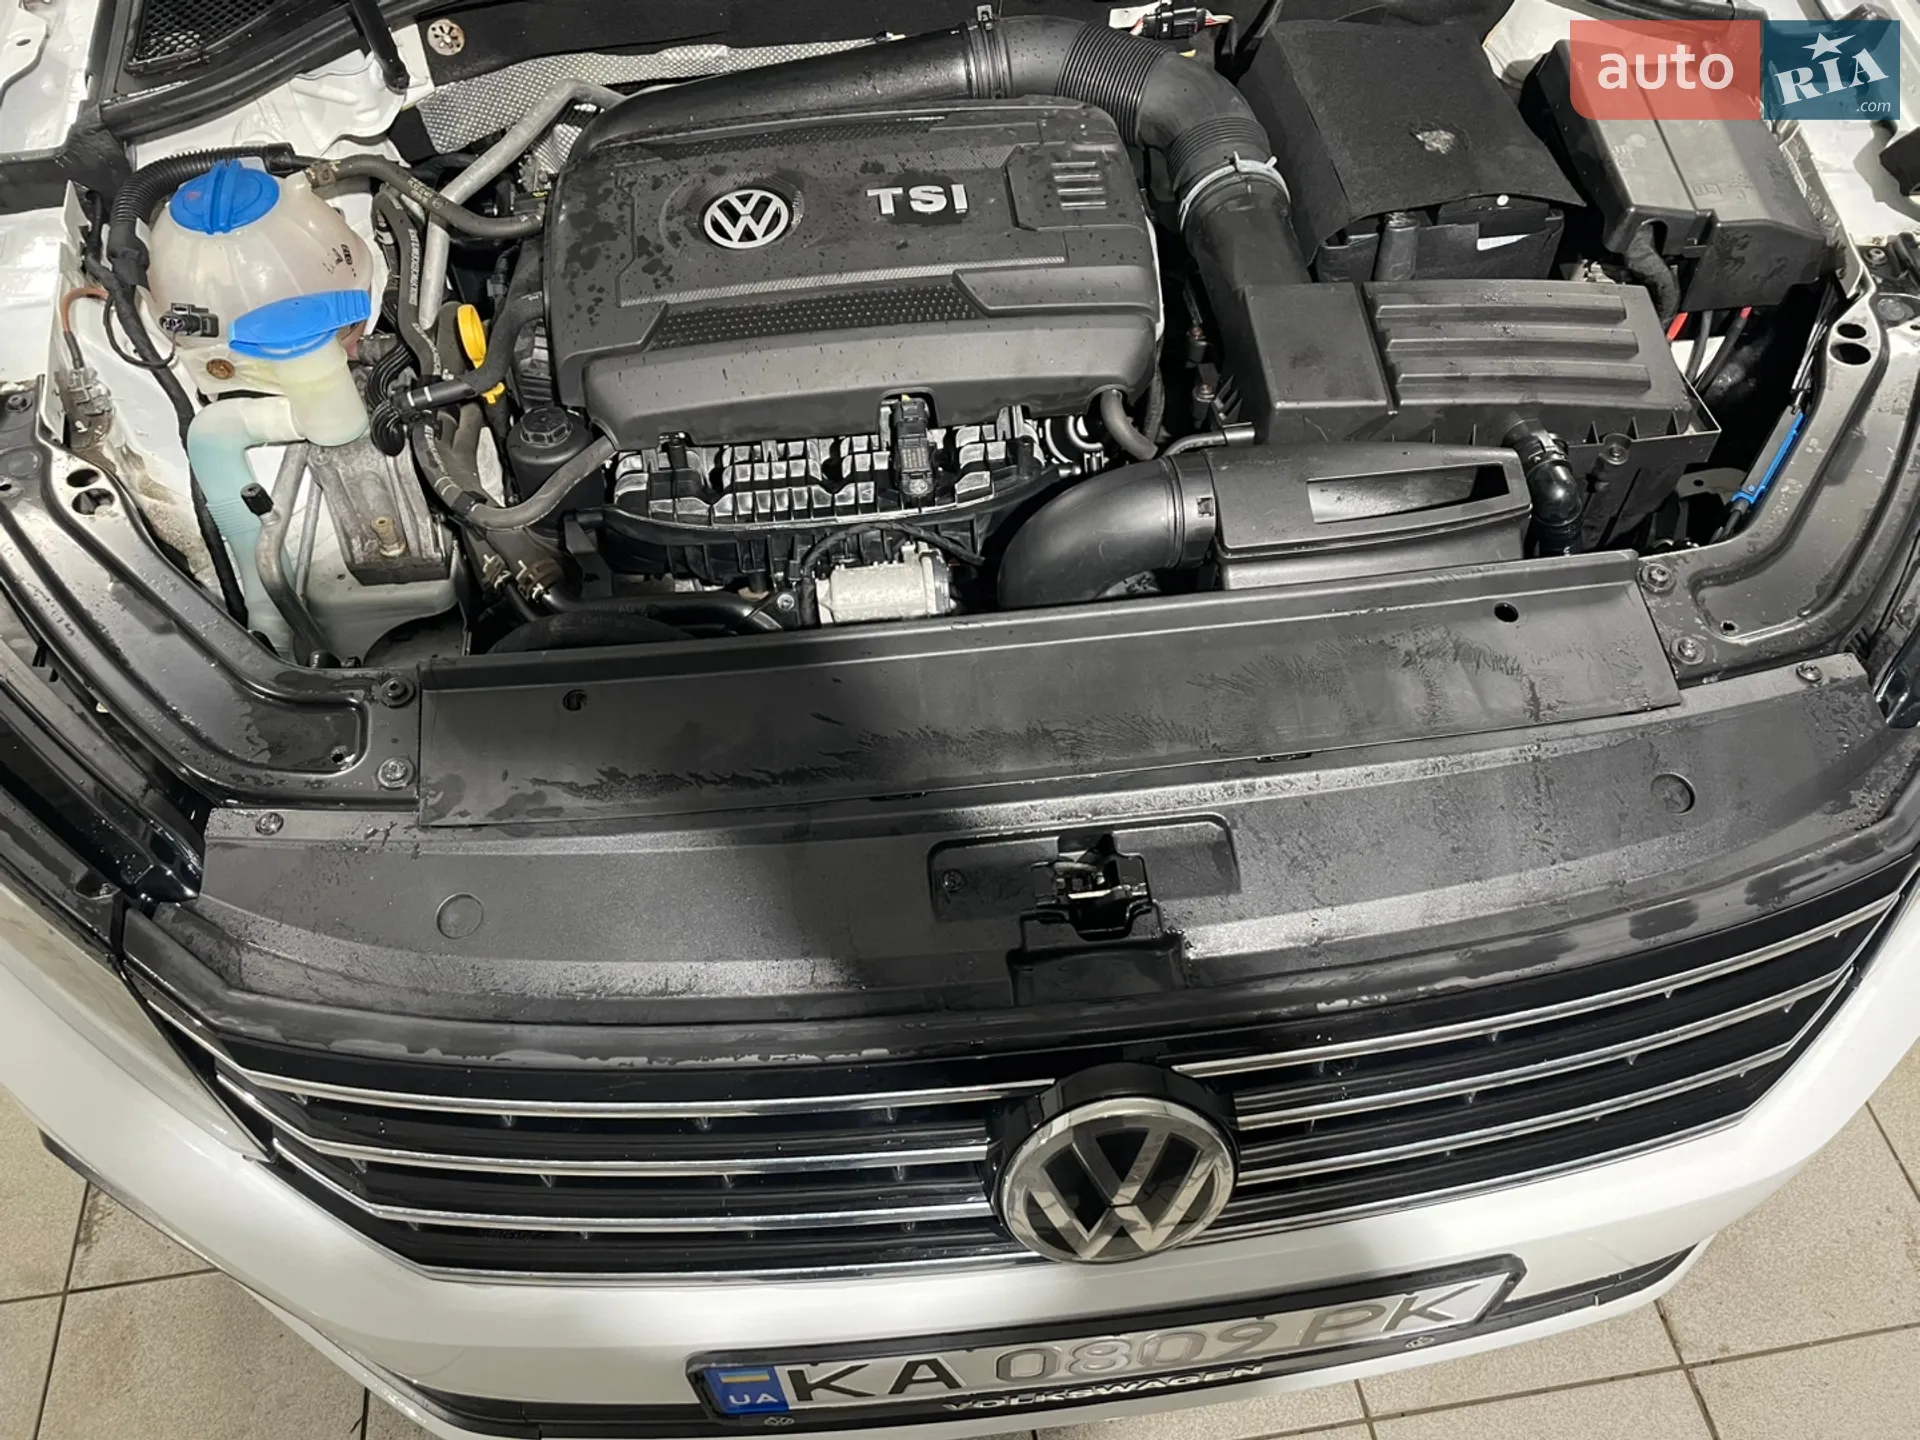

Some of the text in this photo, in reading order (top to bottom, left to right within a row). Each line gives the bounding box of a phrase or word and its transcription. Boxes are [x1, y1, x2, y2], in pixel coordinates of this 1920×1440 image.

[867, 184, 968, 216] TSI
[787, 1282, 1482, 1401] KA 0809 PK
[729, 1392, 778, 1405] UA
[942, 1364, 1264, 1411] VOLKSWAGEN
